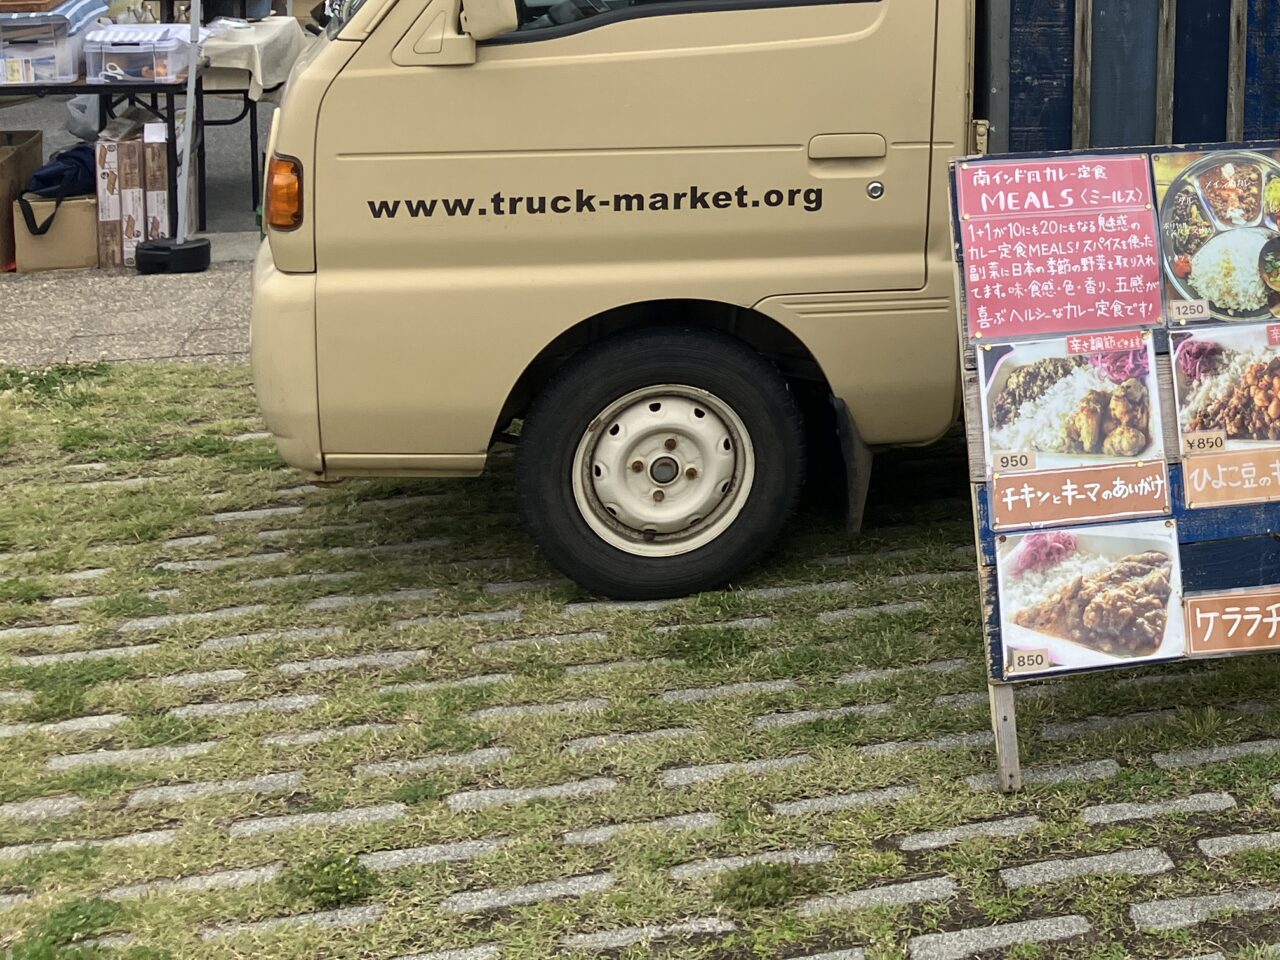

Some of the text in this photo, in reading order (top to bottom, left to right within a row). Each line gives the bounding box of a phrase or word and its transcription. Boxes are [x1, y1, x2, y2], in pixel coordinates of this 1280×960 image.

[367, 185, 824, 219] www.truck-market.org
[980, 188, 1075, 212] MEALS
[968, 254, 1156, 282] 副菜に日本の季節の野菜を取り入れ
[1174, 303, 1205, 317] 1250
[1186, 436, 1223, 450] ¥850
[999, 454, 1028, 468] 950
[1016, 654, 1045, 668] 850
